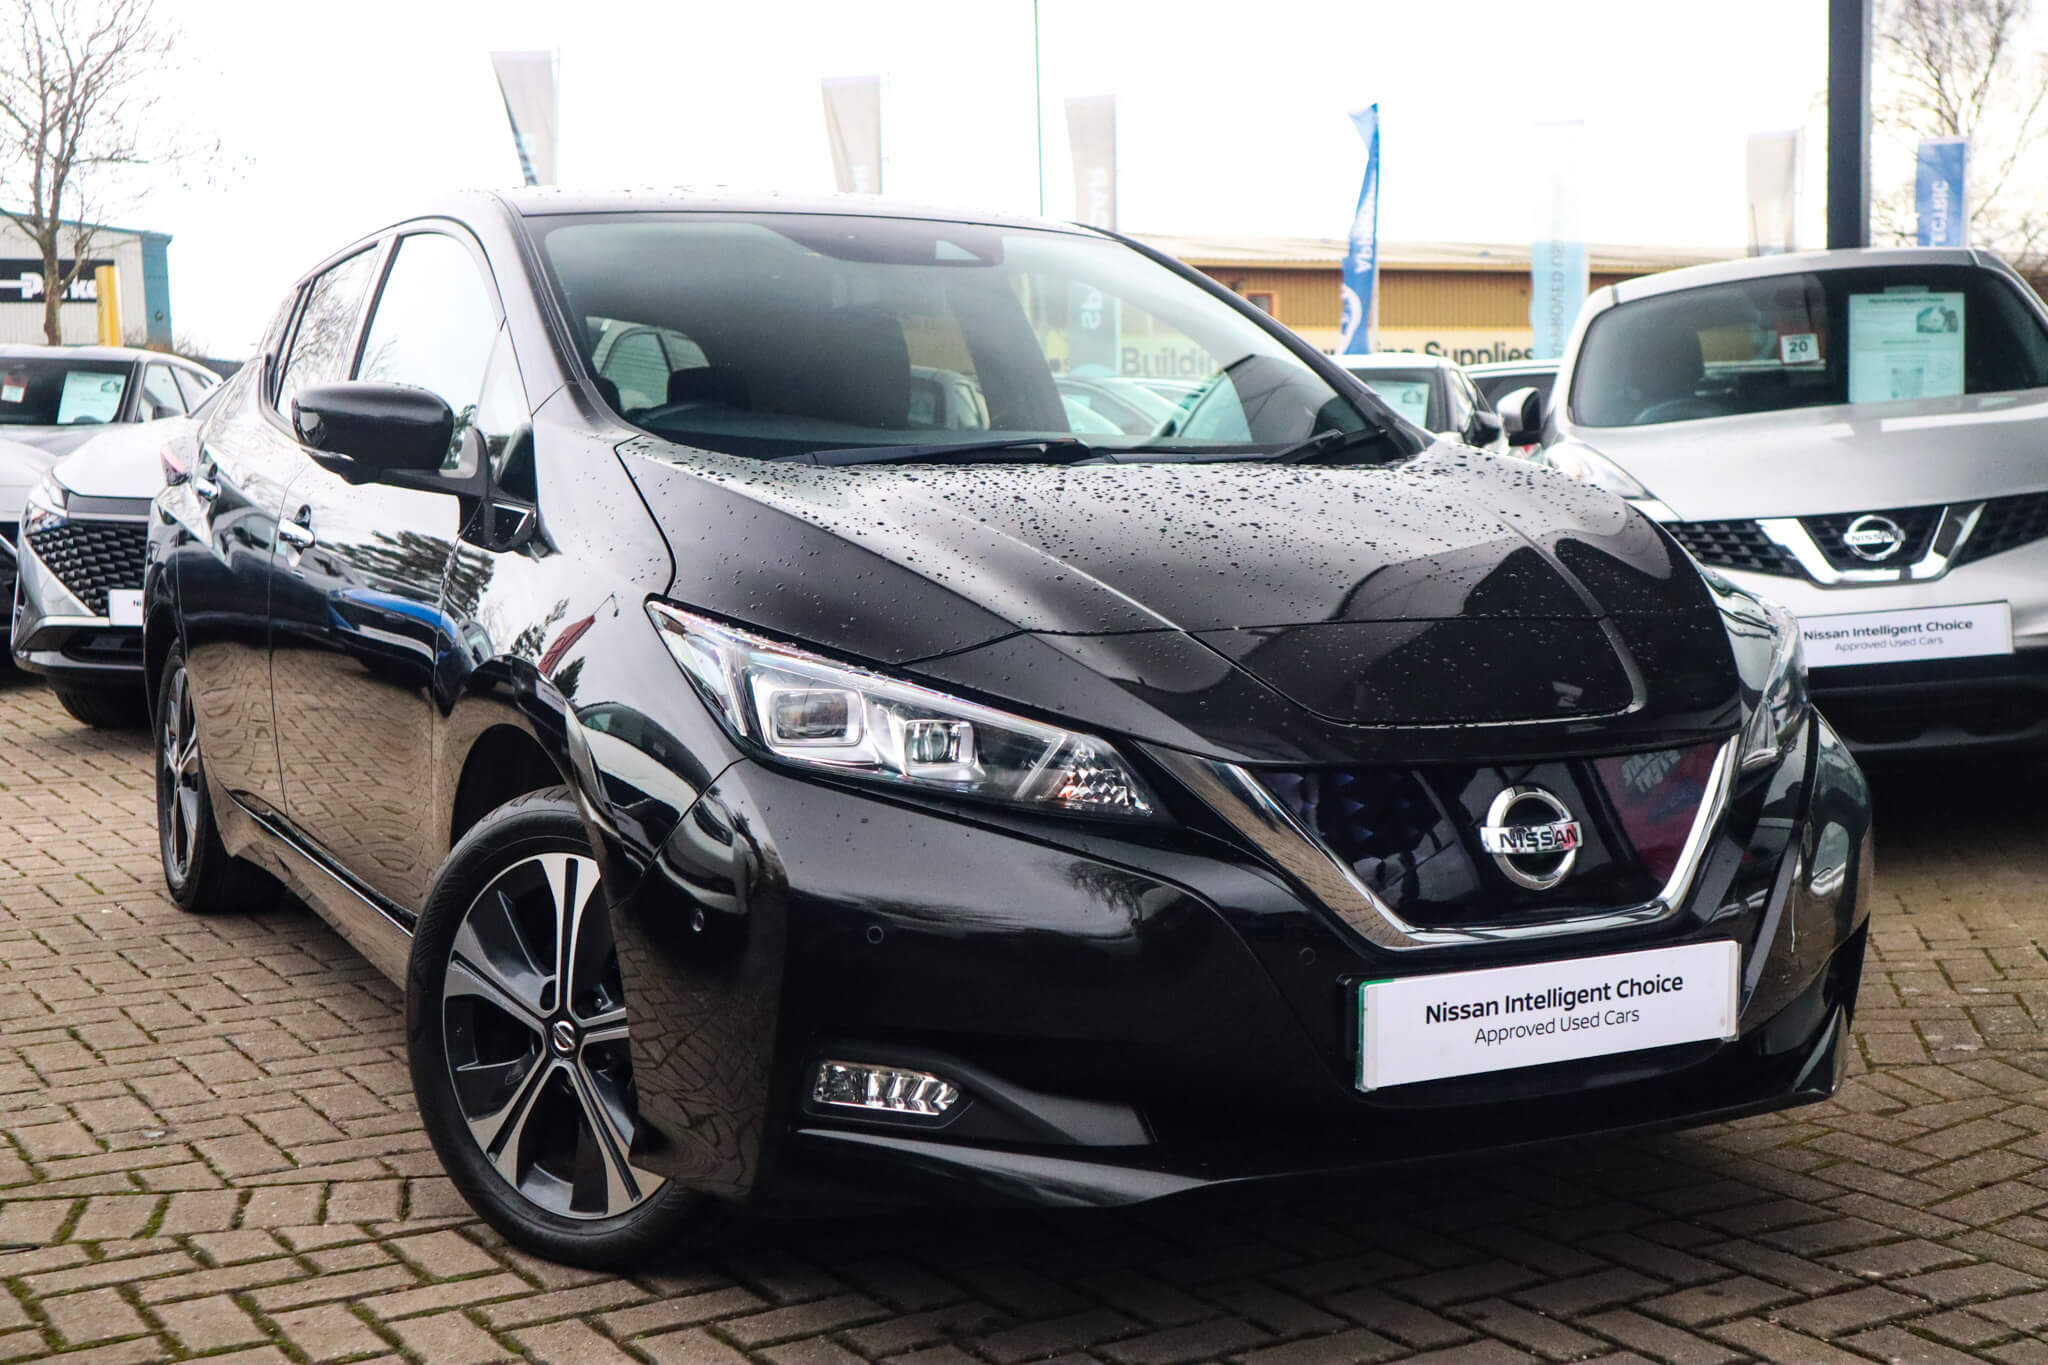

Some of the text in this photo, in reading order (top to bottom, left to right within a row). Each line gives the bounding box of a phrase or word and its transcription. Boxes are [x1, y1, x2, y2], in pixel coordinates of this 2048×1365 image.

[1121, 346, 1214, 376] Buildi
[1803, 619, 1974, 641] Nissan Intelligent Choice
[1834, 635, 1944, 653] Approved Used Cars
[1499, 827, 1578, 849] NISSAN
[1425, 974, 1684, 1025] Nissan Intelligent Choice
[1474, 1008, 1640, 1046] Approved Used Cars
